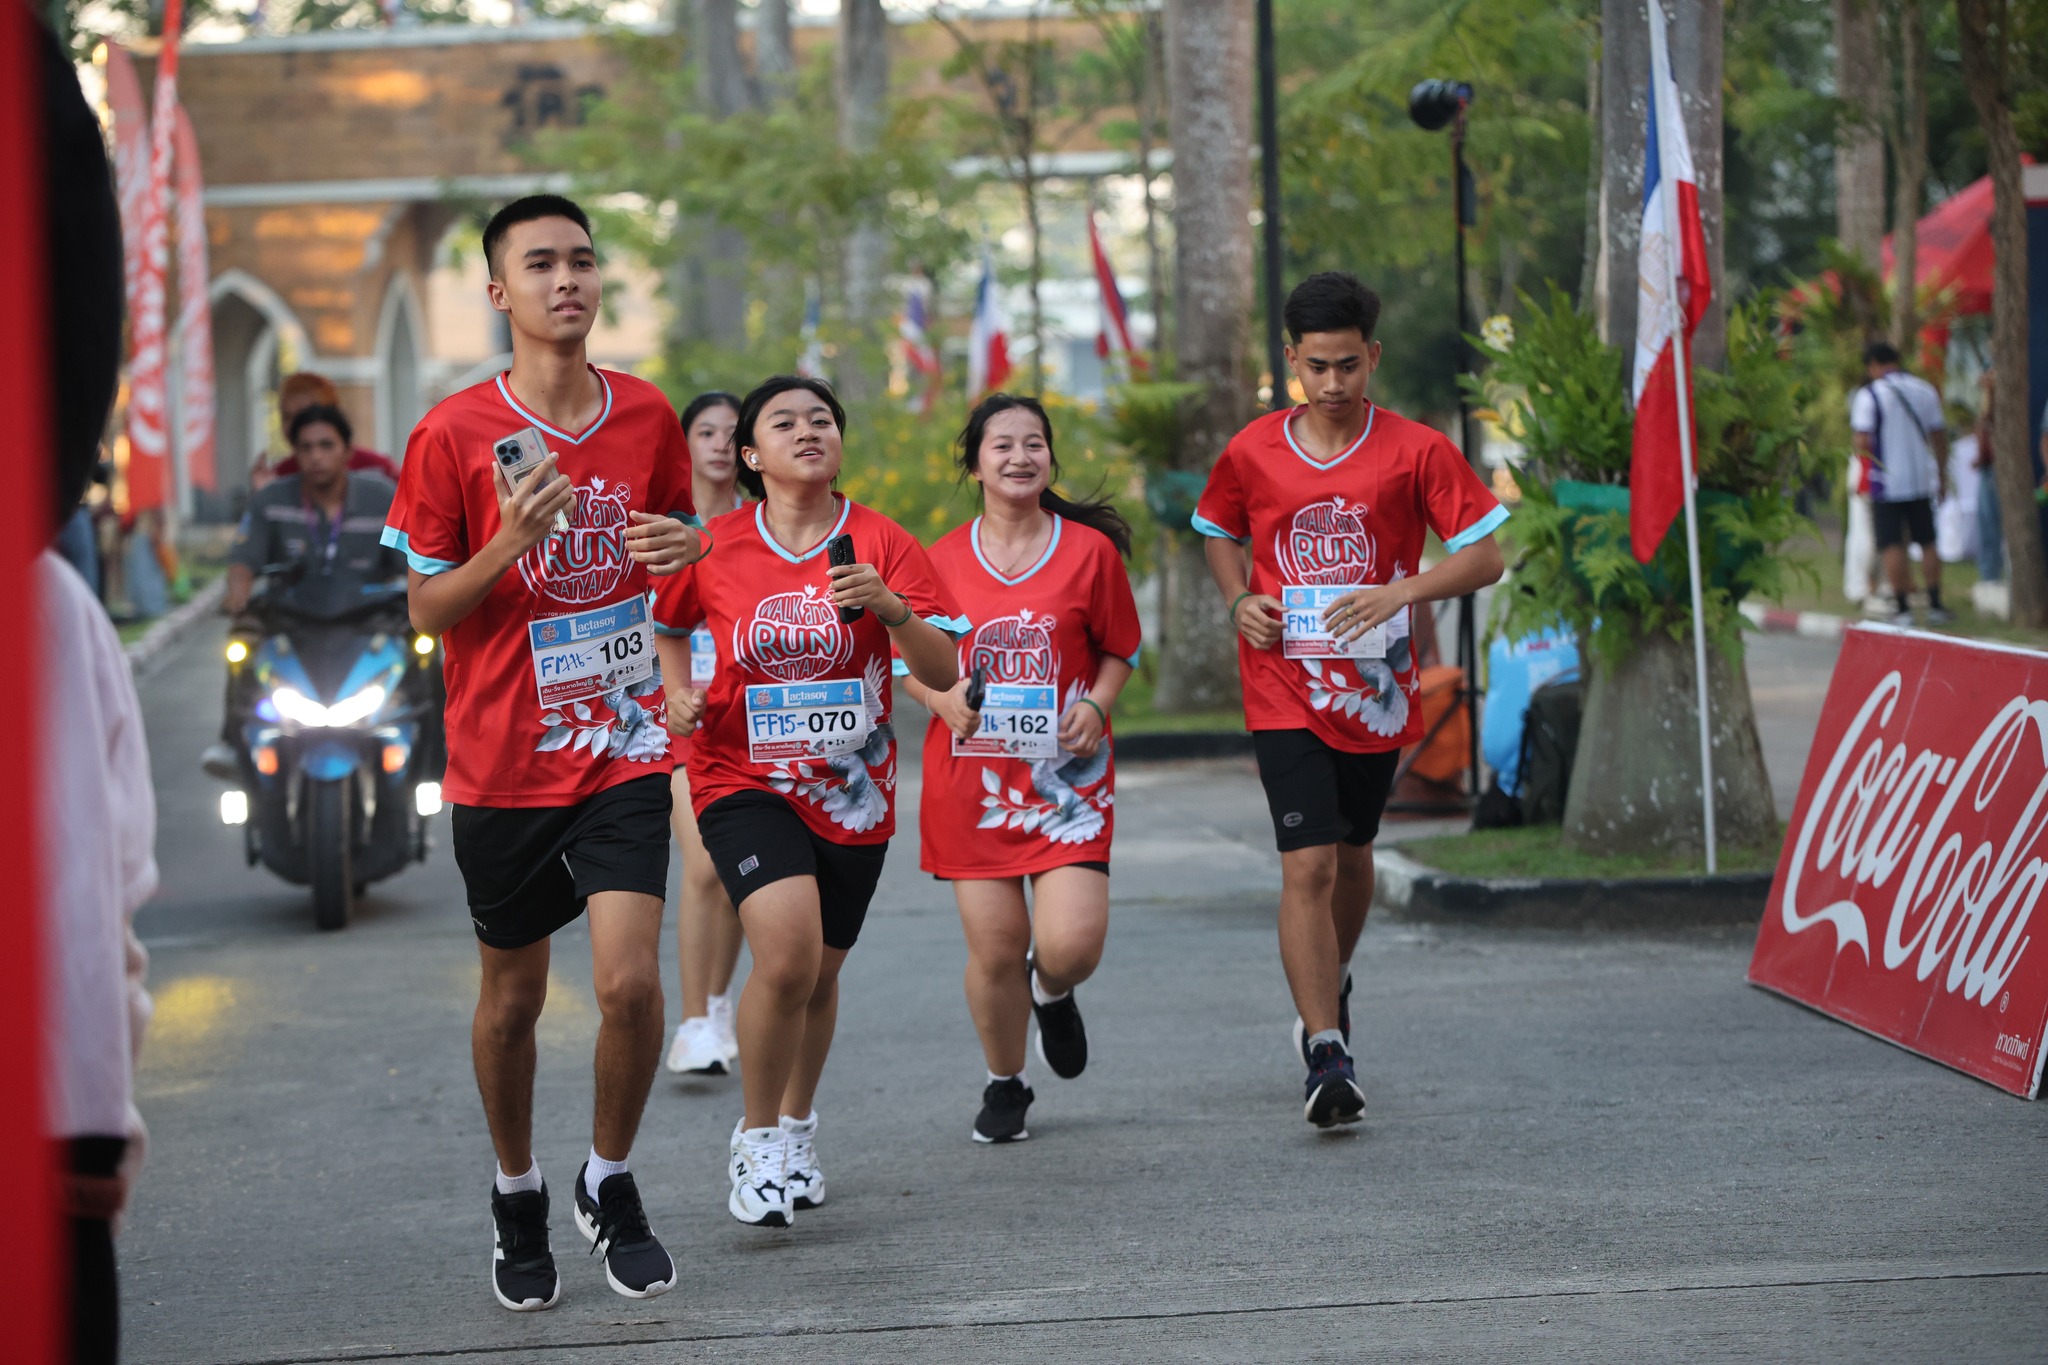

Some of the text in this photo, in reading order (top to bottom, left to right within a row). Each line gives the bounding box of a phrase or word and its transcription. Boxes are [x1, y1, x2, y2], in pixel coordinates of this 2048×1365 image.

[593, 502, 622, 527] and
[1297, 507, 1359, 533] WALK and
[544, 528, 625, 573] RUN
[1295, 534, 1365, 569] RUN
[630, 602, 639, 616] 4
[761, 597, 832, 625] WALK and
[569, 615, 616, 640] Lactasoy
[980, 621, 1045, 648] WALK and
[755, 624, 835, 661] RUN
[975, 649, 1047, 682] RUN
[782, 688, 828, 707] Lactasoy
[844, 685, 854, 697] 4
[1038, 690, 1048, 702] 4
[983, 714, 1049, 734] 16-162
[1782, 670, 2048, 1007] Coca-Cola
[1995, 1033, 2031, 1060] หาดทิพย์
